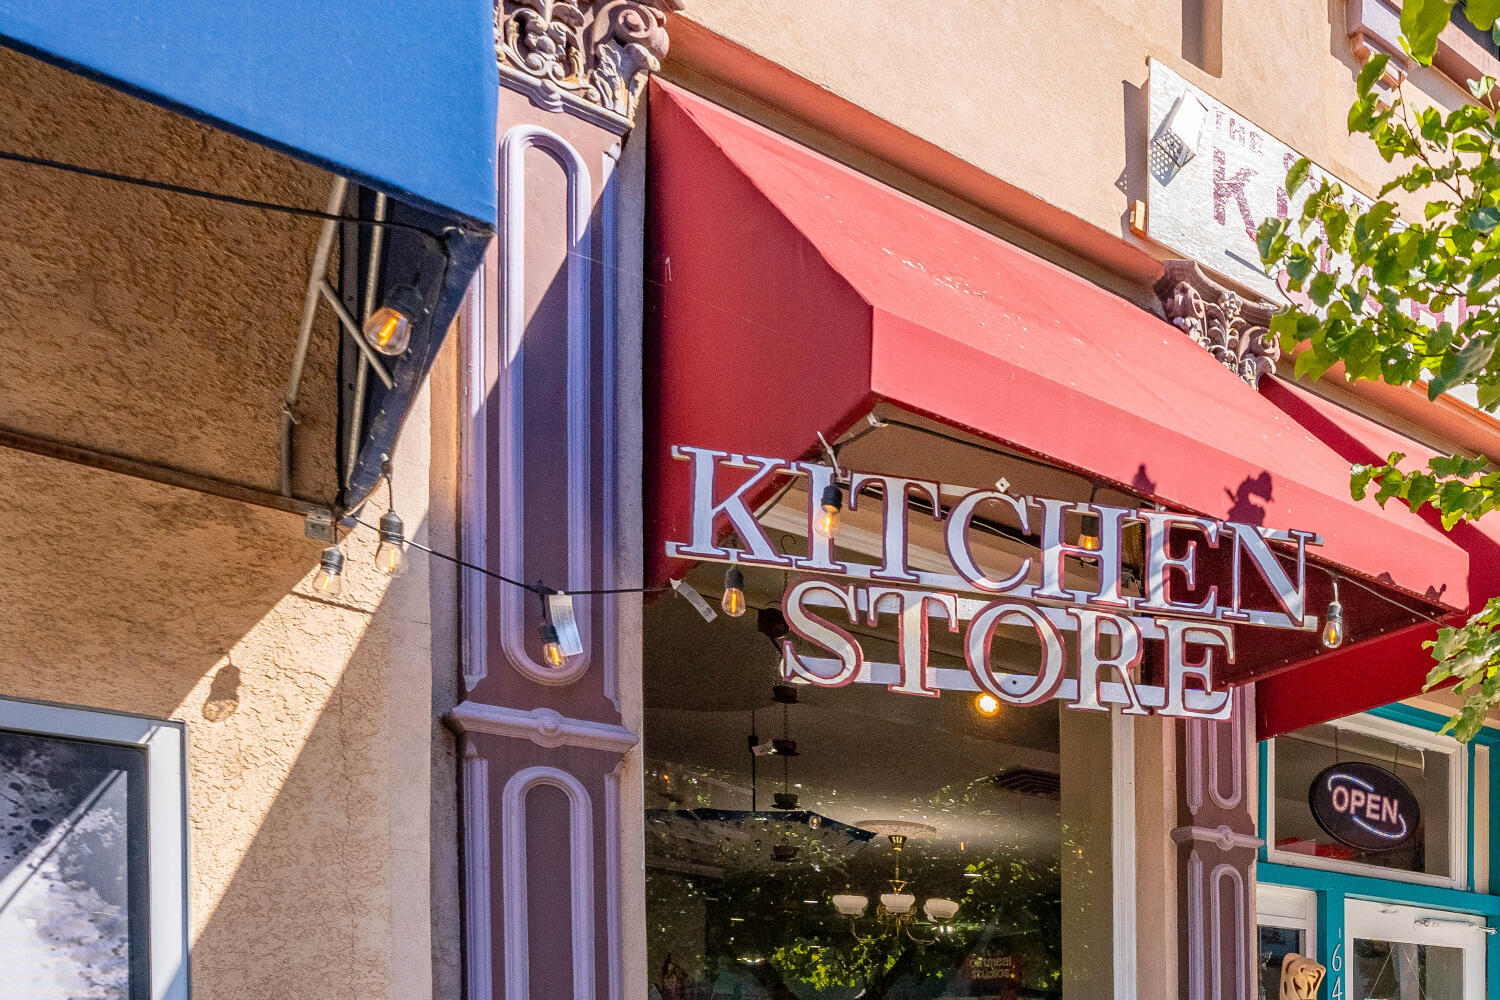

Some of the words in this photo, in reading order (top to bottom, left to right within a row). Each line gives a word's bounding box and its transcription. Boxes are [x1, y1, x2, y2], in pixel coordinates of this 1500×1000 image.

[677, 445, 1318, 630] KITCHEN
[781, 579, 1236, 721] STORE
[1332, 785, 1399, 825] OPEN
